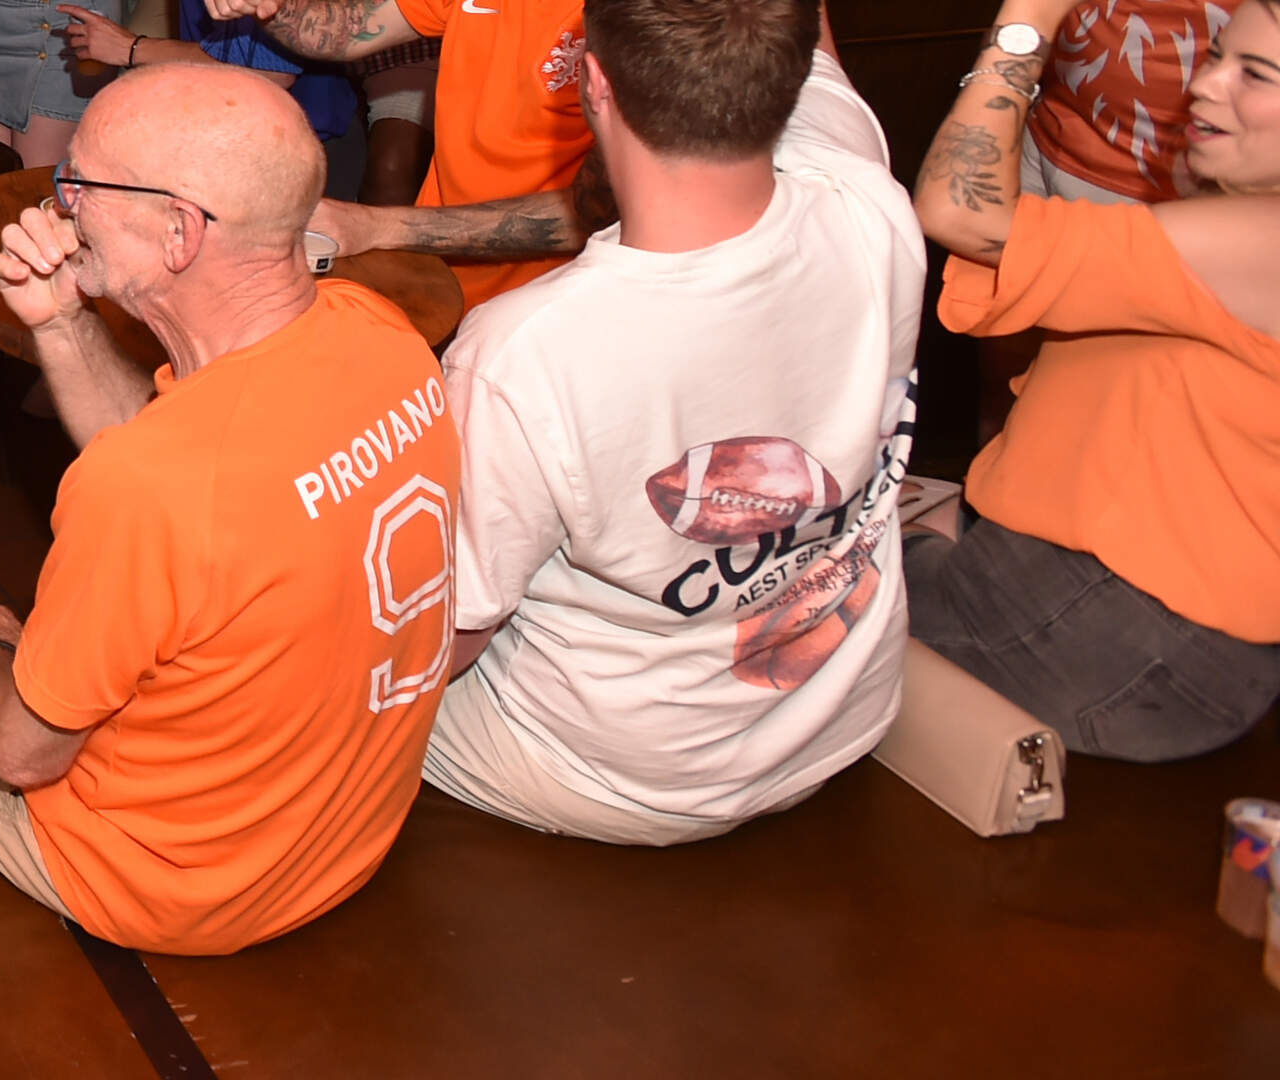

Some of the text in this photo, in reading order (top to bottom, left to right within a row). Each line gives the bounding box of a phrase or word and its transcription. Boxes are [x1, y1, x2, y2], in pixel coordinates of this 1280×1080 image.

[294, 377, 445, 520] PIROVANO
[363, 473, 455, 714] 9
[734, 562, 788, 611] AEST
